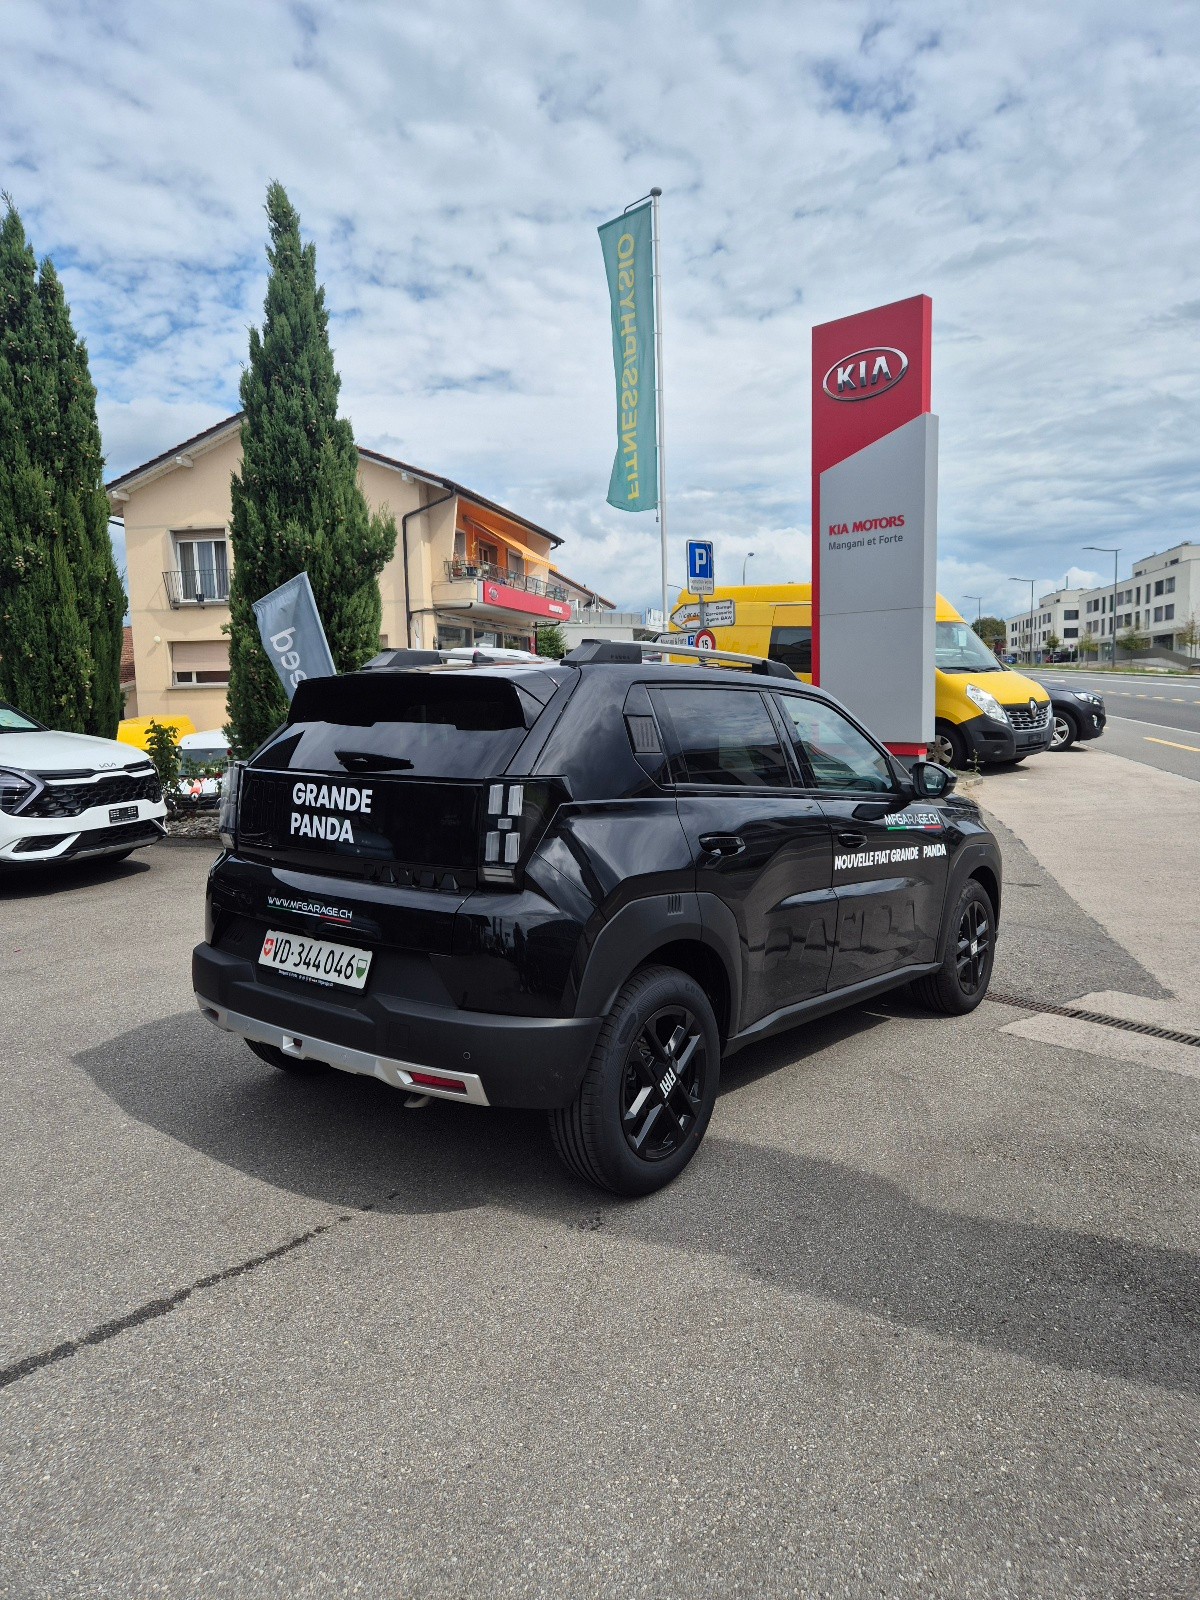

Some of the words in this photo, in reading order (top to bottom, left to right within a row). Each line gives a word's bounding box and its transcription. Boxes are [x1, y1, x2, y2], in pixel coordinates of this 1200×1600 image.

[837, 356, 892, 393] KIA
[829, 523, 849, 536] KIA
[852, 515, 905, 533] MOTORS
[829, 538, 865, 550] Mangani
[867, 537, 876, 546] et
[879, 534, 904, 544] Forte
[695, 548, 707, 574] P
[701, 639, 709, 649] 15
[292, 782, 373, 813] GRANDE
[290, 812, 355, 844] PANDA
[834, 848, 874, 870] NOUVELLE
[874, 849, 890, 865] FIAT
[890, 846, 919, 862] GRANDE
[923, 843, 947, 858] PANDA
[267, 896, 353, 919] WWW.MFGARAGE.CH
[659, 1067, 677, 1099] FIAT
